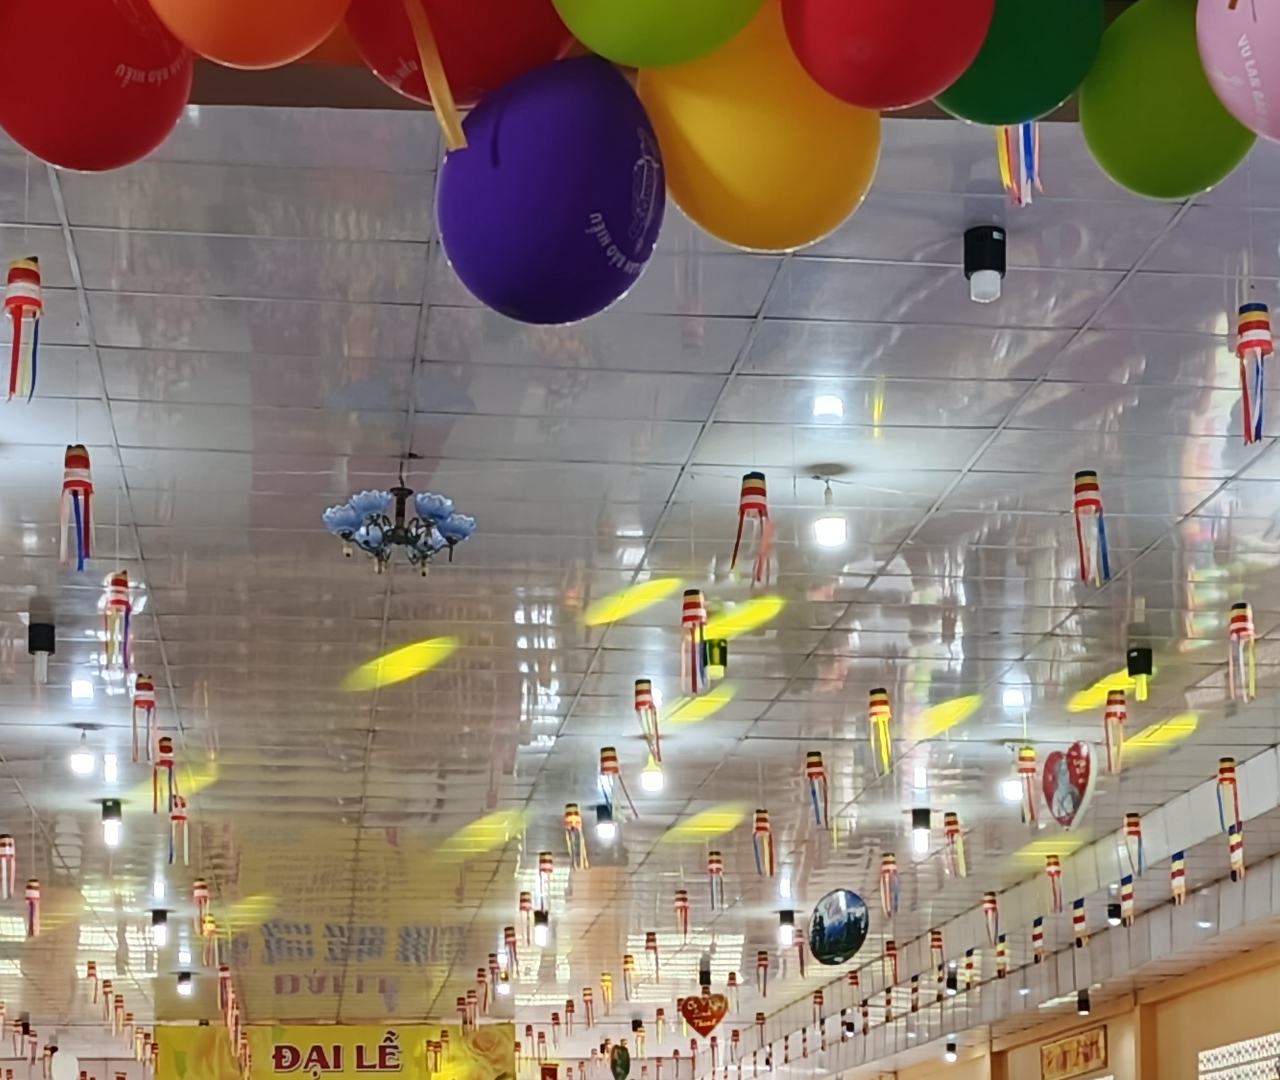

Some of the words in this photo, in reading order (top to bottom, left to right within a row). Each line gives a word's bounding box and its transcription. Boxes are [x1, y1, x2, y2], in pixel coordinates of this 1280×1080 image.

[1237, 33, 1252, 58] VU
[1245, 59, 1261, 87] LAN
[271, 1043, 345, 1080] ĐẠI
[355, 1029, 404, 1073] LỄ
